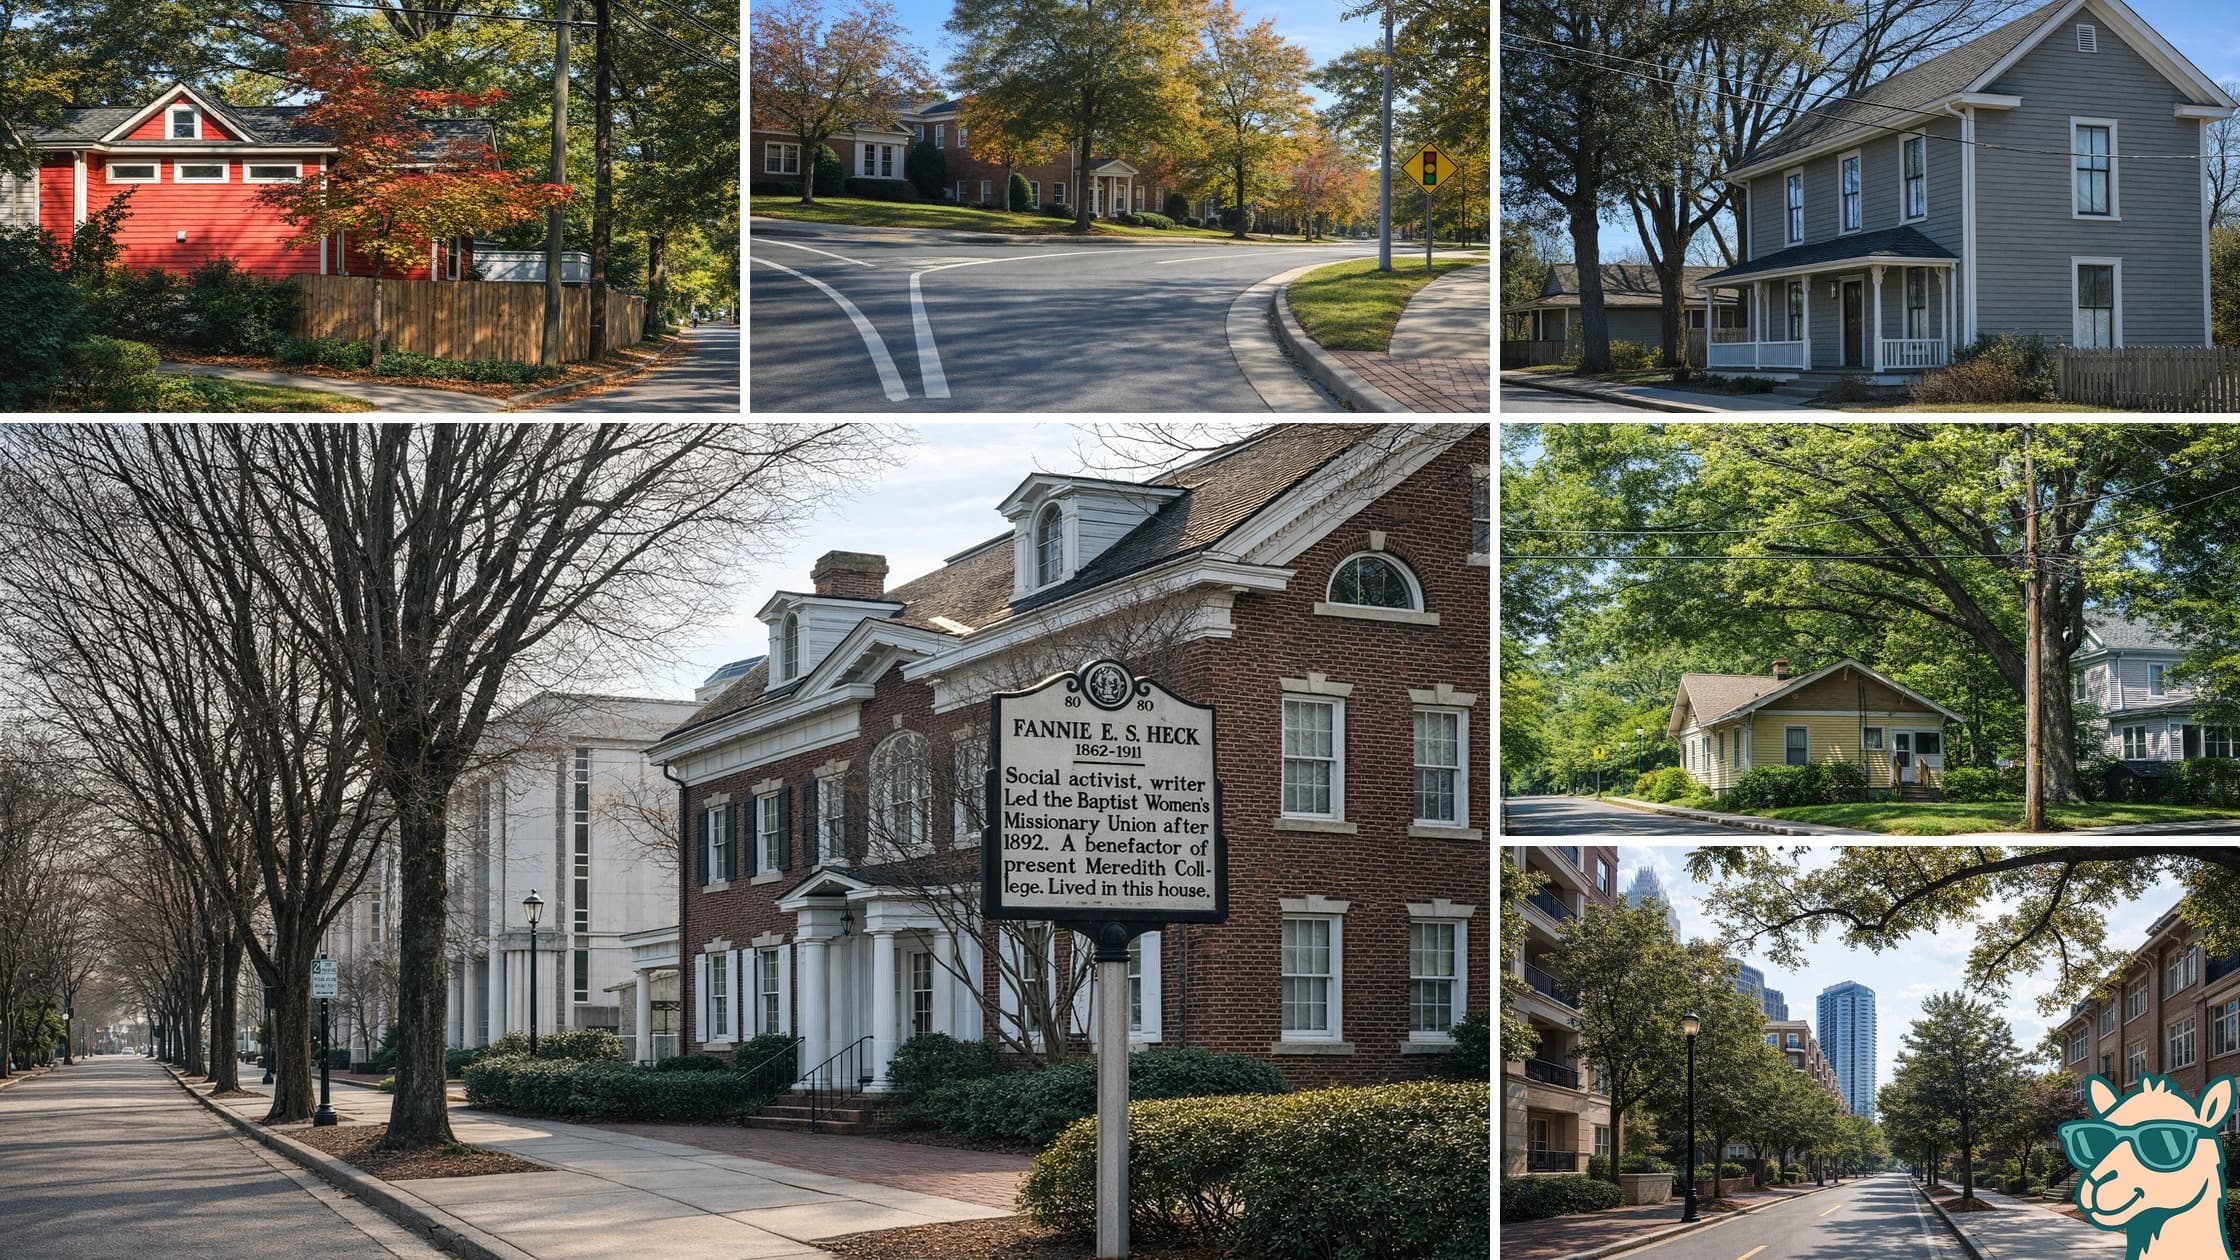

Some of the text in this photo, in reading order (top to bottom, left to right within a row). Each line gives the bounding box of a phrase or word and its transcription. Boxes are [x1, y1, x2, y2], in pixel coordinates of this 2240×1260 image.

[1065, 697, 1081, 707] 80
[1137, 700, 1153, 711] 80
[1013, 719, 1200, 745] FANNIE E. S. HECK
[1075, 744, 1142, 759] 1862-1911
[1006, 767, 1060, 785] Social
[1150, 778, 1205, 792] writer
[1005, 789, 1209, 813] Led the Baptist Women's
[1005, 812, 1209, 835] Missionary Union after
[1004, 834, 1208, 856] 1892. A benefactor of
[1005, 858, 1211, 879] present Meredith Coll-
[1048, 878, 1096, 895] Lived
[1102, 880, 1116, 895] in
[1122, 881, 1153, 896] this
[1158, 882, 1210, 898] house.
